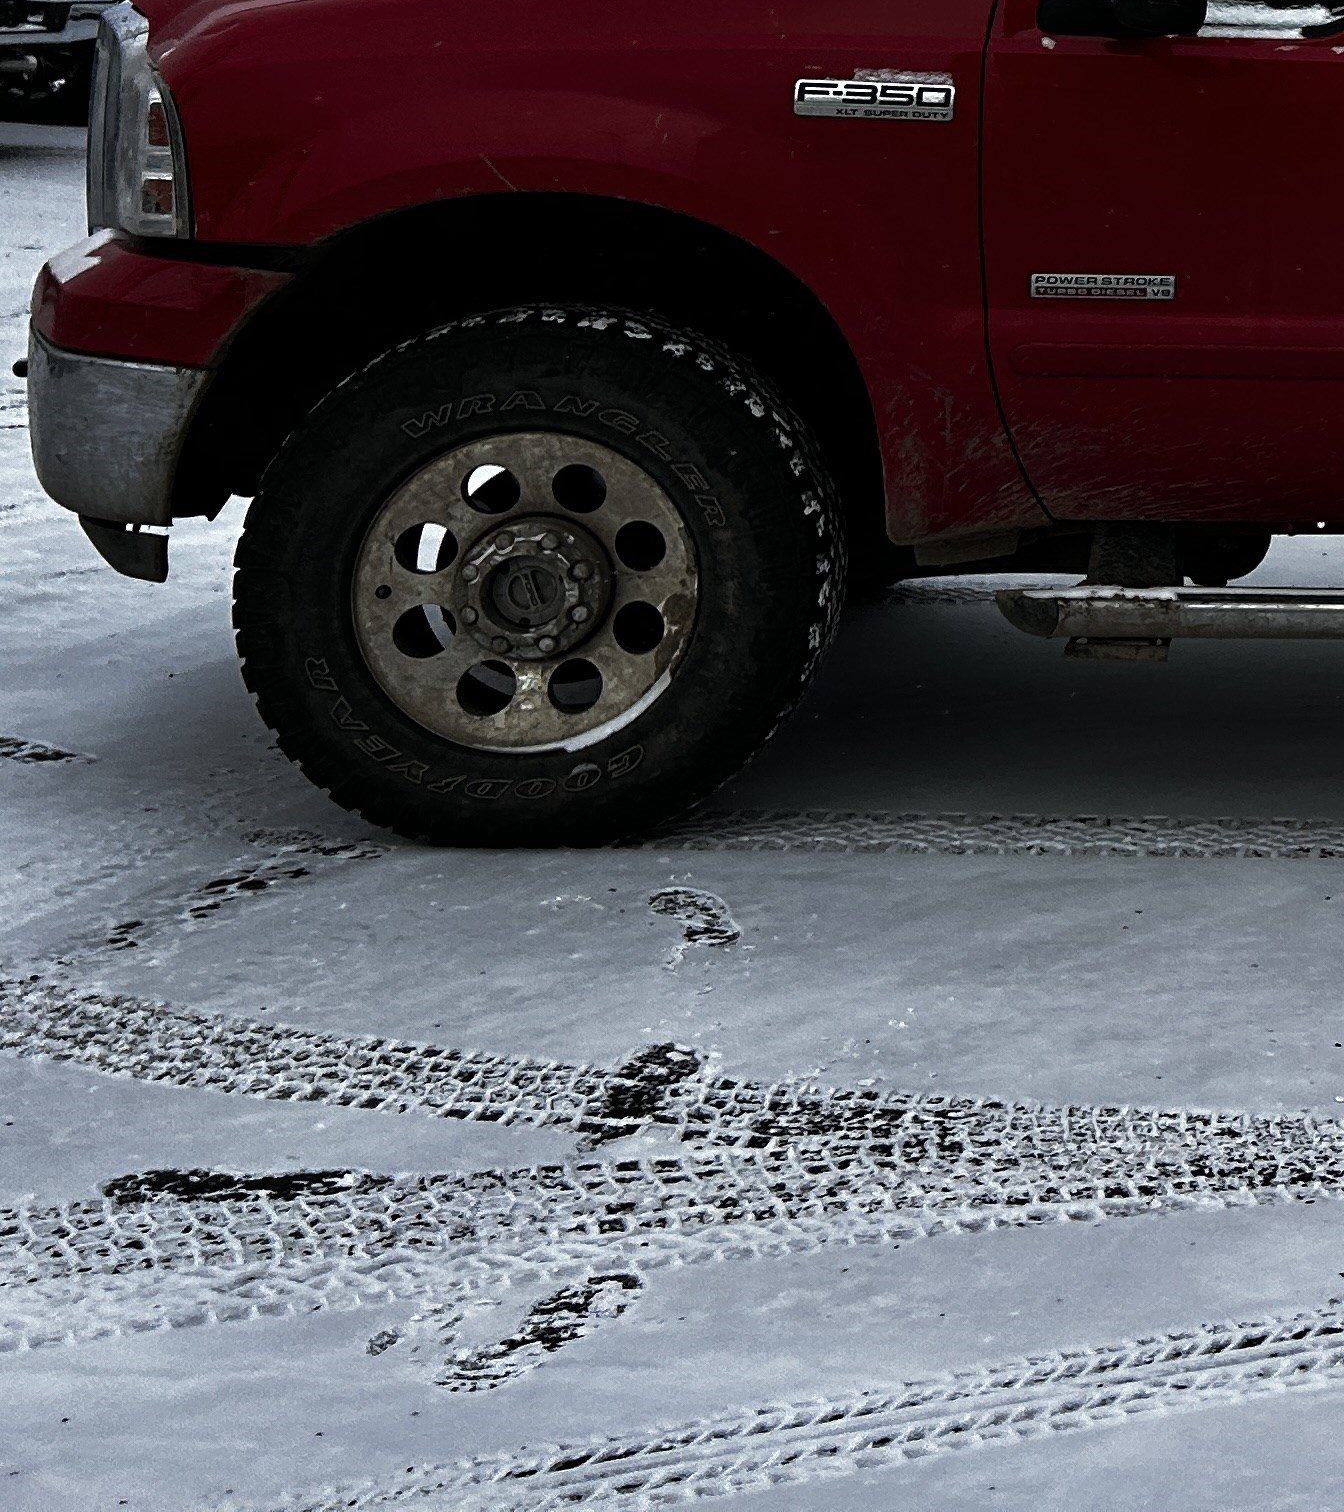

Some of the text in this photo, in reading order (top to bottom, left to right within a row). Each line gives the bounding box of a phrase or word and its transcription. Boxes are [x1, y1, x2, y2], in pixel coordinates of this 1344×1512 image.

[797, 82, 951, 107] F-350
[836, 108, 948, 119] XLT SUPER DUTY
[1035, 276, 1171, 286] POWER STROKE
[1037, 287, 1170, 297] TURBO DIESEL V8
[401, 390, 726, 528] WRANGLER
[305, 656, 645, 799] GOODYEAR
